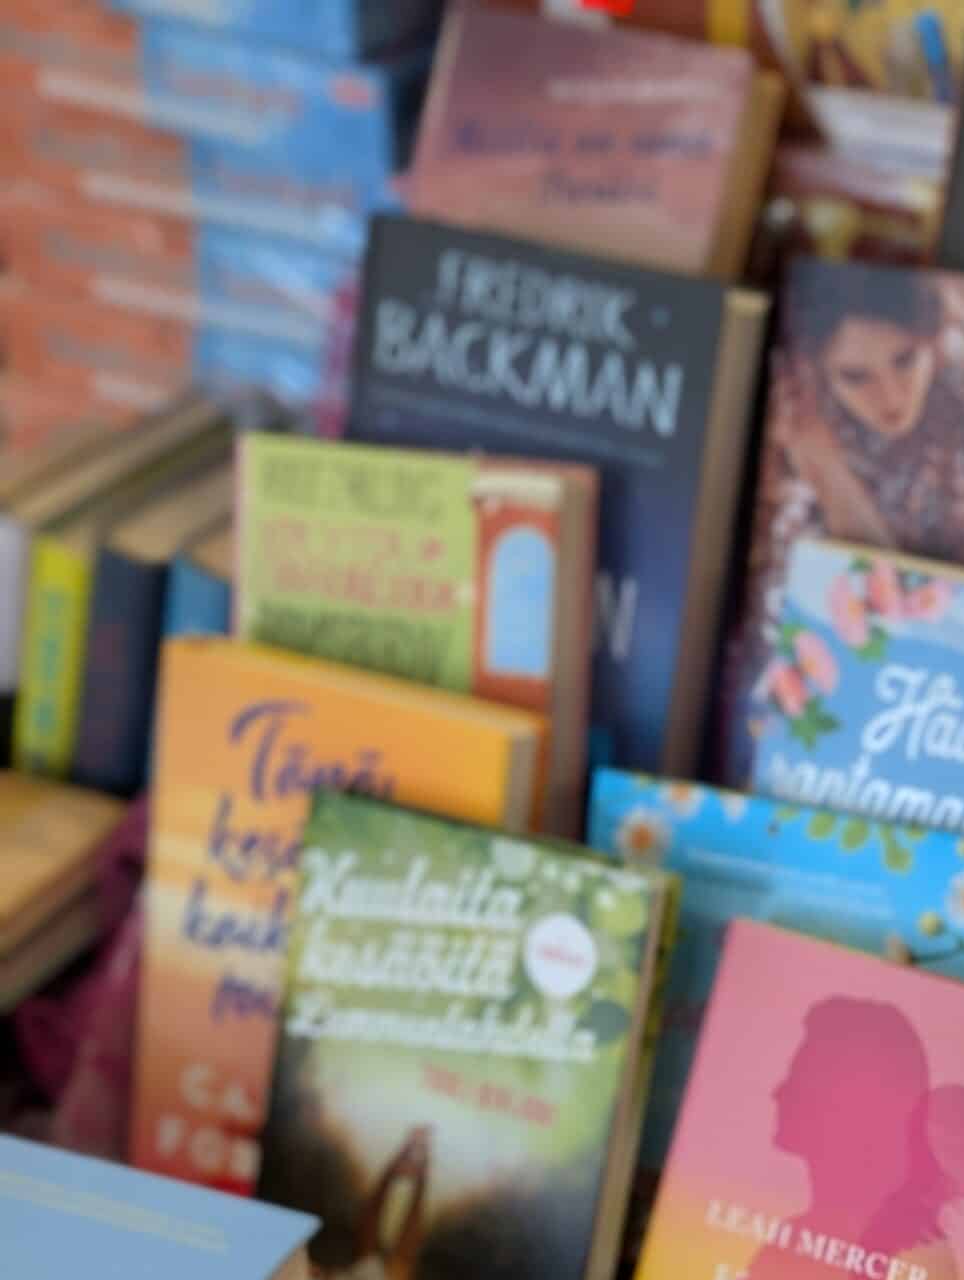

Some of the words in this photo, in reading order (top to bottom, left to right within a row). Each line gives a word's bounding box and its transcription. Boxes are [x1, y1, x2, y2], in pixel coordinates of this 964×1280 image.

[437, 252, 634, 344] FREDRIK
[372, 304, 684, 438] BACKMAN
[704, 1199, 794, 1254] LEAH
